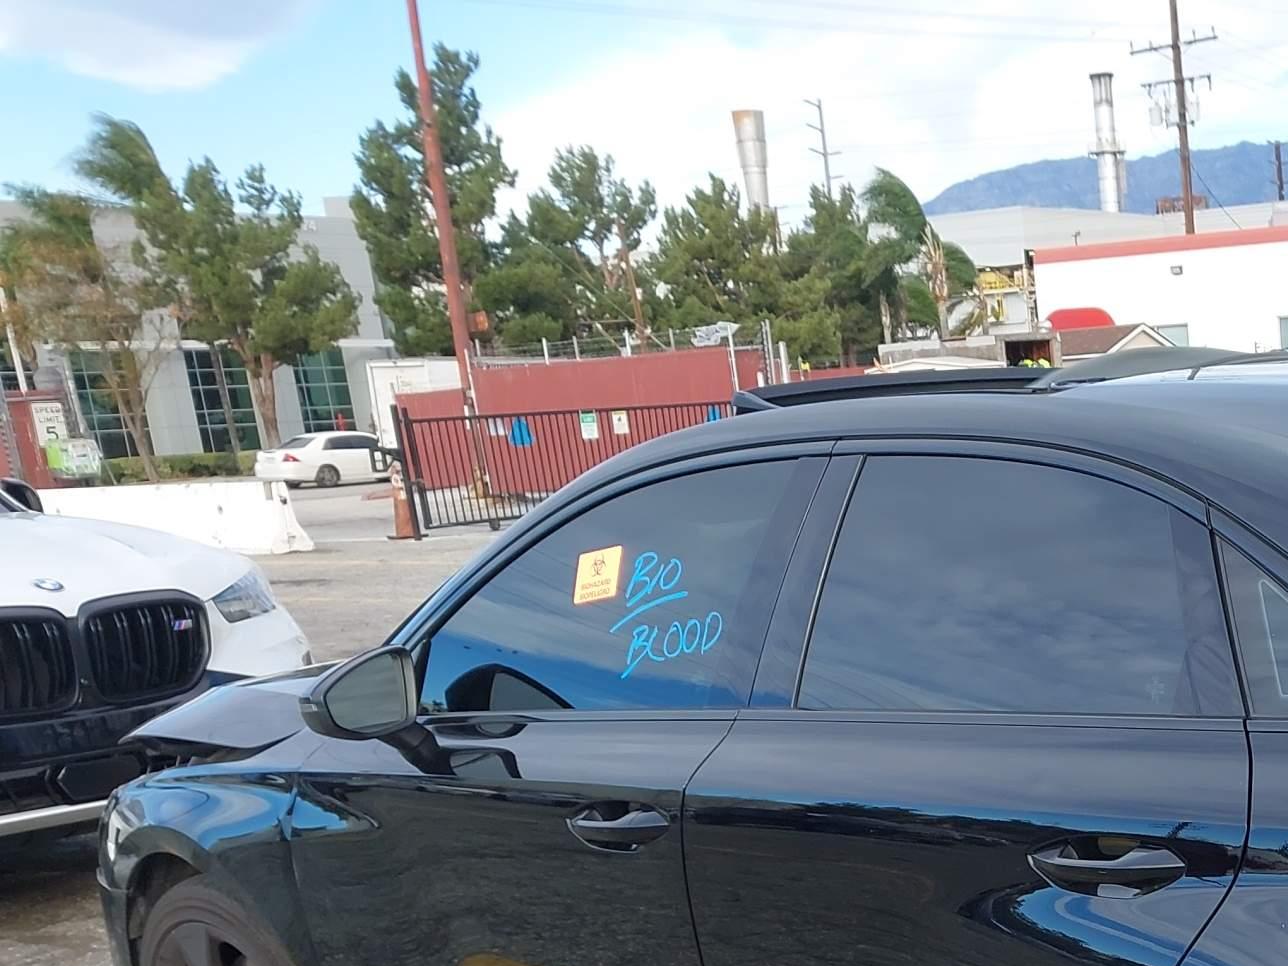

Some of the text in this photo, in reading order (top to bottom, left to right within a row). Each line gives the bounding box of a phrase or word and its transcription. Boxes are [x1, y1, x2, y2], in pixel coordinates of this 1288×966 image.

[38, 415, 64, 423] LIMIT
[46, 426, 59, 440] 5
[625, 551, 682, 607] BIO
[621, 611, 723, 679] BLOOD
